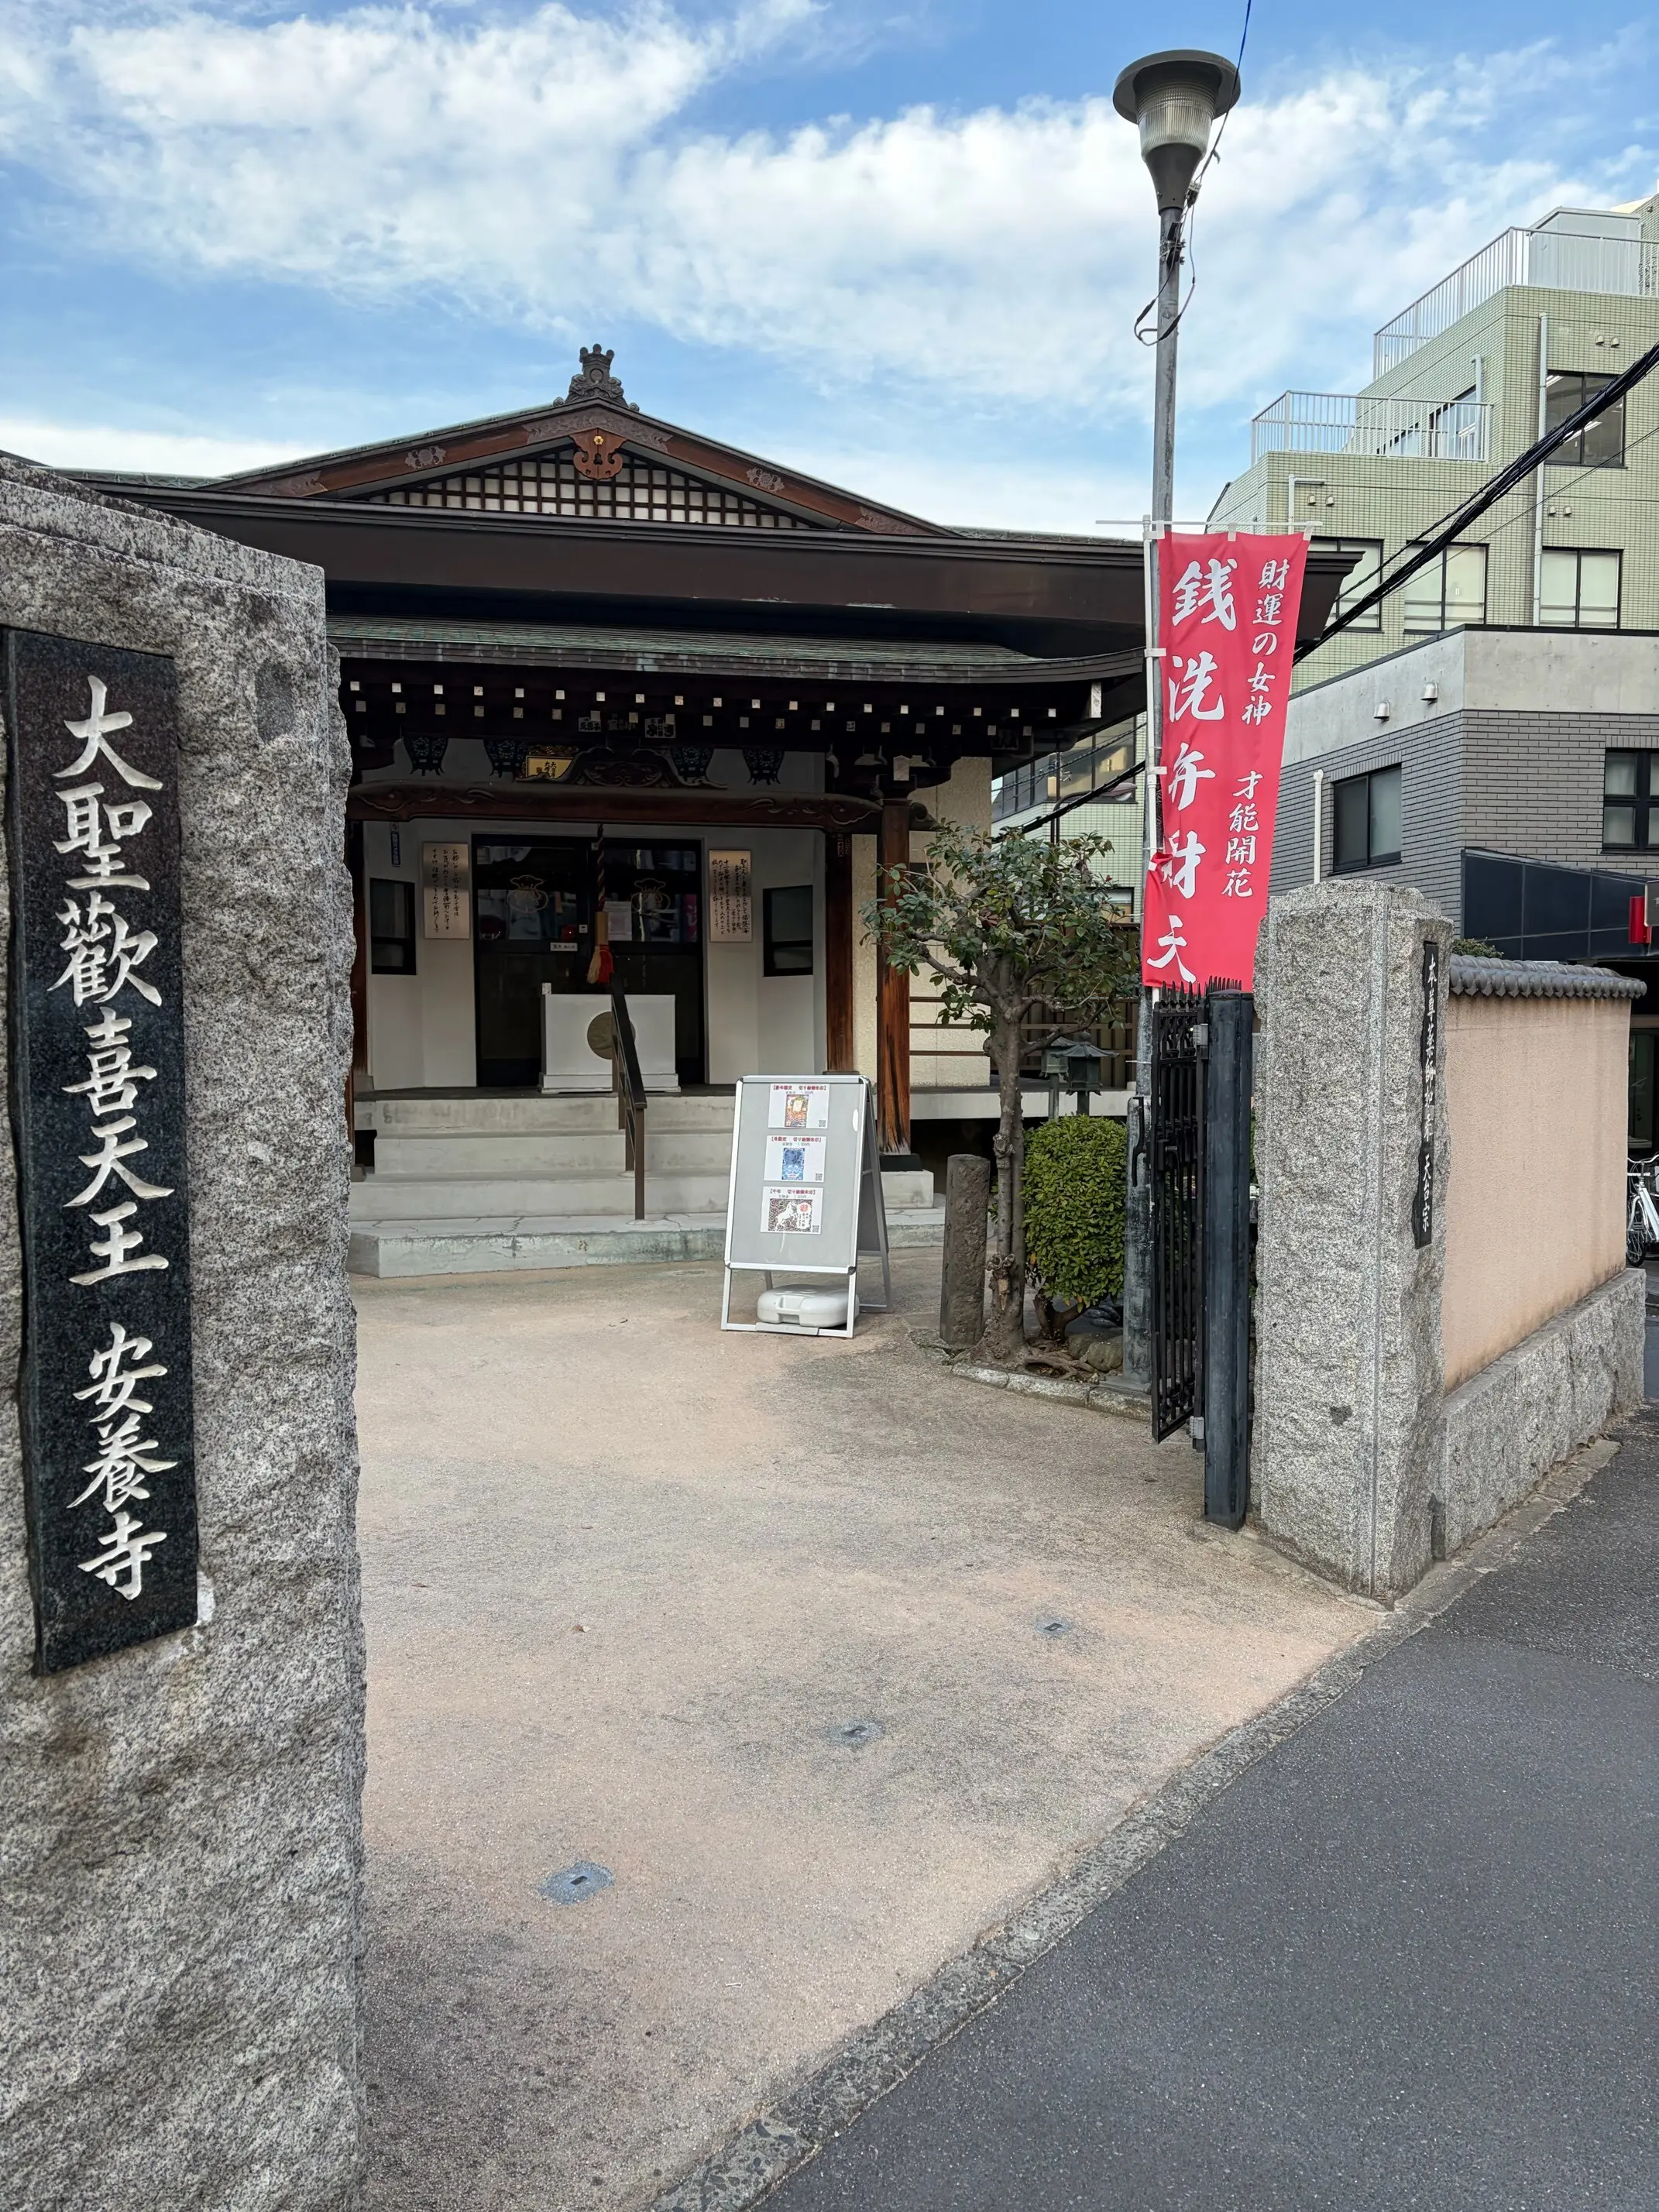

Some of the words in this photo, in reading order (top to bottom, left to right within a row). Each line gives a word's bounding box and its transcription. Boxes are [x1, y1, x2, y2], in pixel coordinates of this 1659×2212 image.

[1242, 558, 1290, 726] 財運の女神
[1221, 771, 1263, 898] 才能開花
[1424, 953, 1437, 1142] 本尊薬師如来
[1422, 1153, 1431, 1233] 天台宗
[67, 1323, 177, 1601] 安養寺
